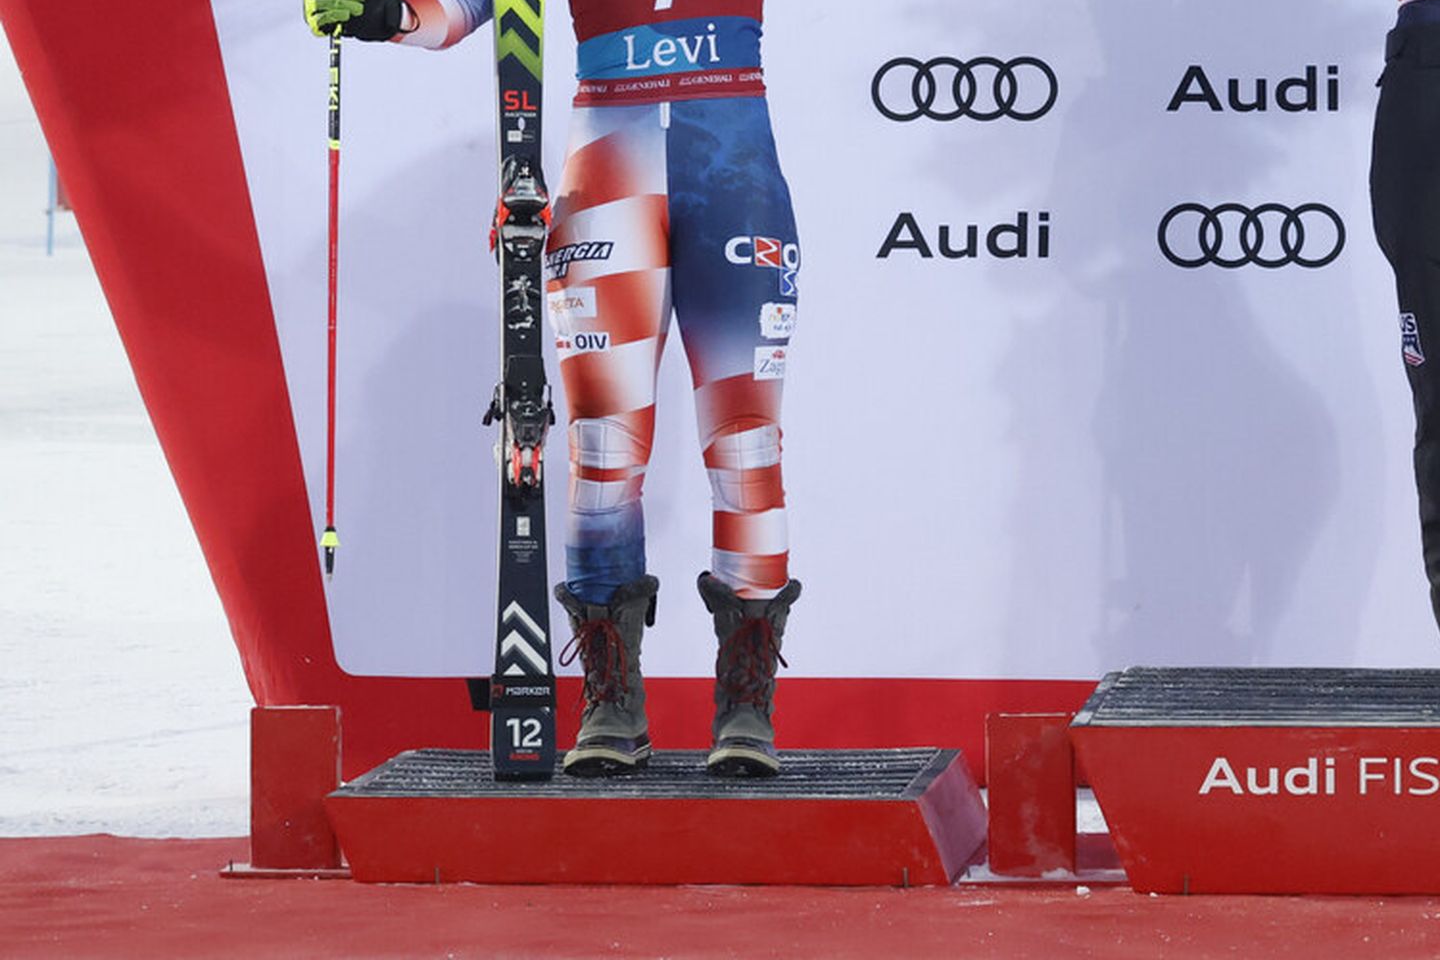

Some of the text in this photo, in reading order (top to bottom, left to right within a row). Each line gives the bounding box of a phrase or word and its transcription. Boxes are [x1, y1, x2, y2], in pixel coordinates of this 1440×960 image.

[623, 23, 720, 70] Levi
[503, 90, 538, 111] SL
[1165, 64, 1339, 113] Audi
[875, 211, 1050, 260] Audi
[506, 718, 543, 747] 12
[1199, 757, 1335, 795] Audi
[1359, 757, 1440, 796] FIS
